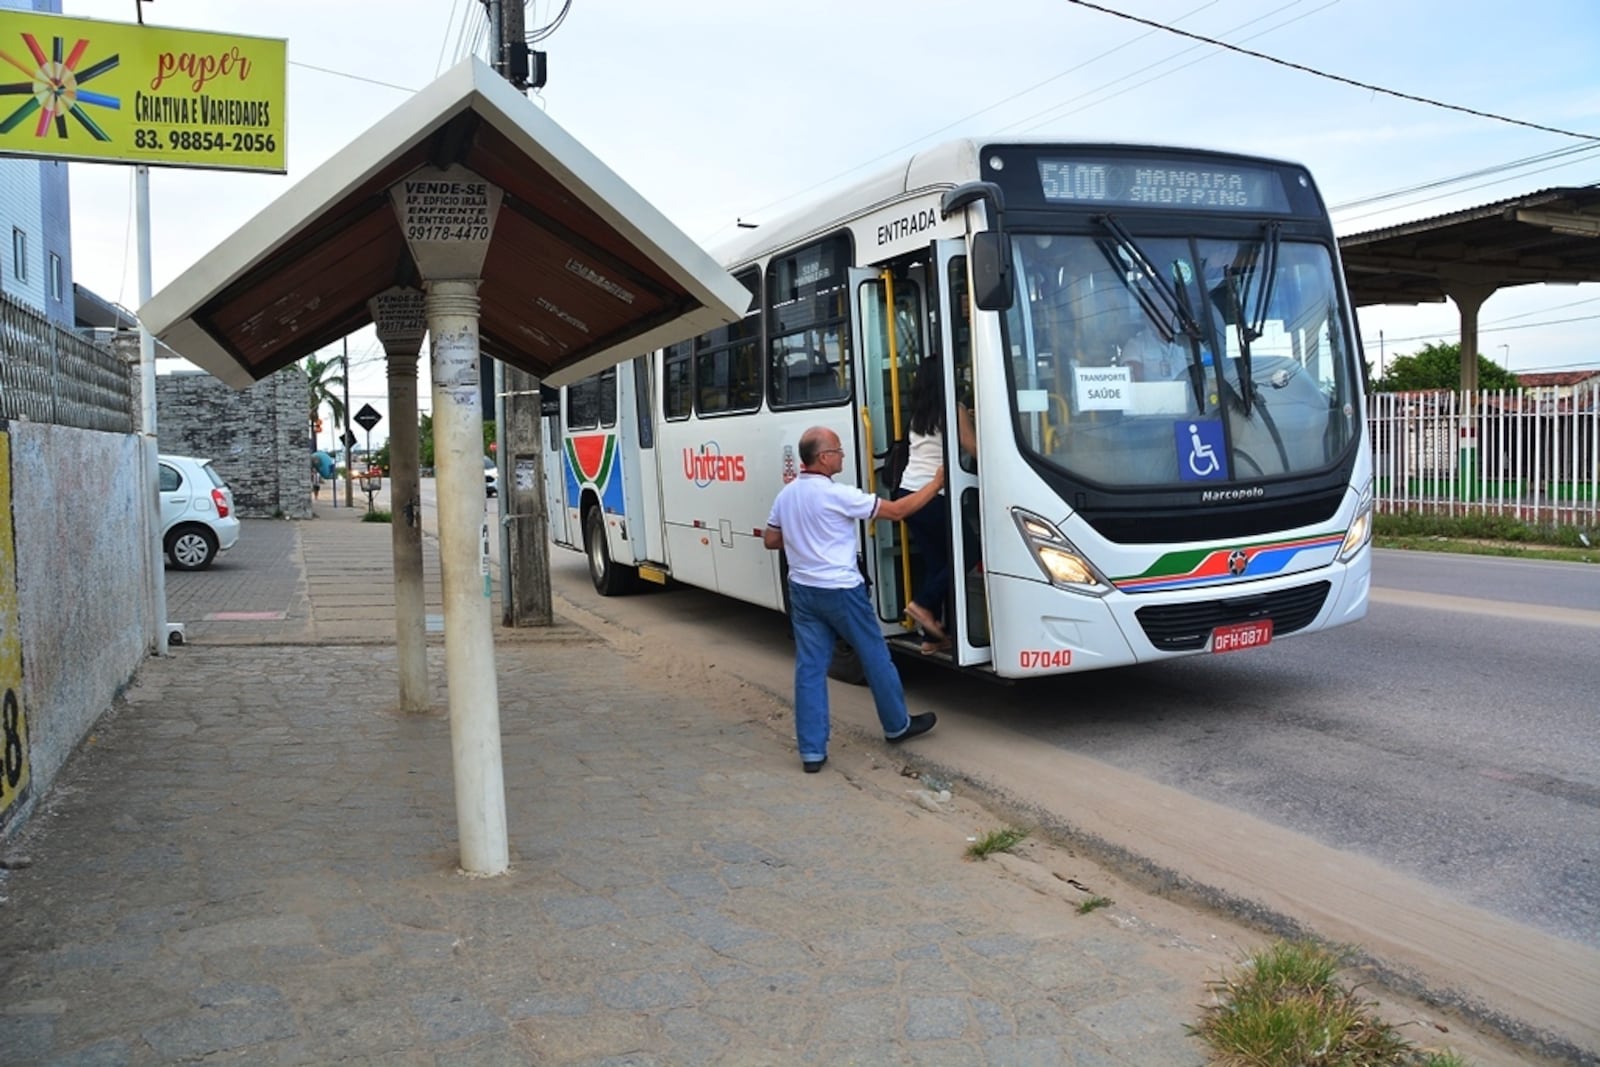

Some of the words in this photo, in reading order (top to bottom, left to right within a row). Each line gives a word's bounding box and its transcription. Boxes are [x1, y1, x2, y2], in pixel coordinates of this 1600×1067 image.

[151, 47, 252, 92] paper
[135, 91, 189, 124] CRIATIVA
[191, 98, 198, 124] E
[200, 95, 270, 127] VARIEDADES
[135, 129, 163, 149] 83.
[169, 132, 276, 152] 98854-2056
[405, 182, 486, 195] VENDE-SE
[1041, 164, 1105, 200] 5100
[1135, 169, 1243, 191] MANAIRA
[1130, 186, 1248, 206] SHOPPING
[407, 226, 489, 240] 99178-4470
[878, 208, 936, 245] ENTRADA
[1080, 373, 1126, 381] TRANSPORTE
[1088, 387, 1121, 399] SAÚDE
[683, 444, 746, 482] Unitrans
[1202, 486, 1264, 501] Marcopolo
[1020, 649, 1071, 668] 07040
